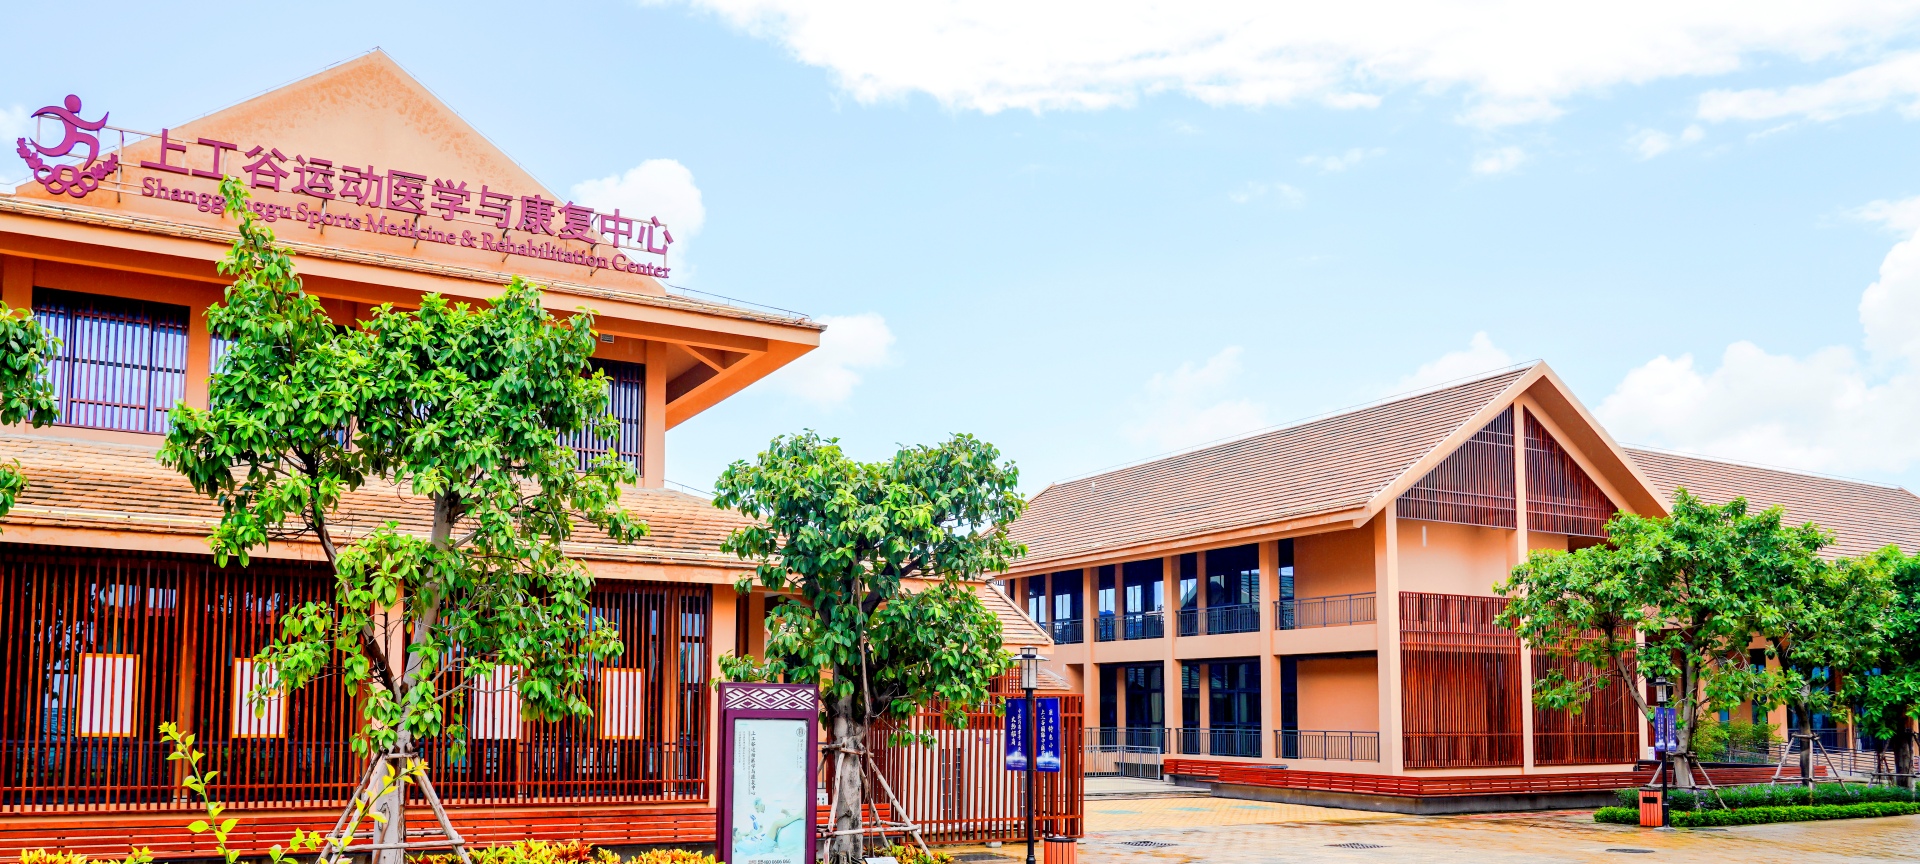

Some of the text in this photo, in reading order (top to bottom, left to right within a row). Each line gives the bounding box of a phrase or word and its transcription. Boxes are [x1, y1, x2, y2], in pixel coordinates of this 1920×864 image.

[140, 128, 674, 255] 上工谷运动医学与康复中心
[141, 176, 671, 279] Shanggnggu Sports Medicine & Rehabilitation Center
